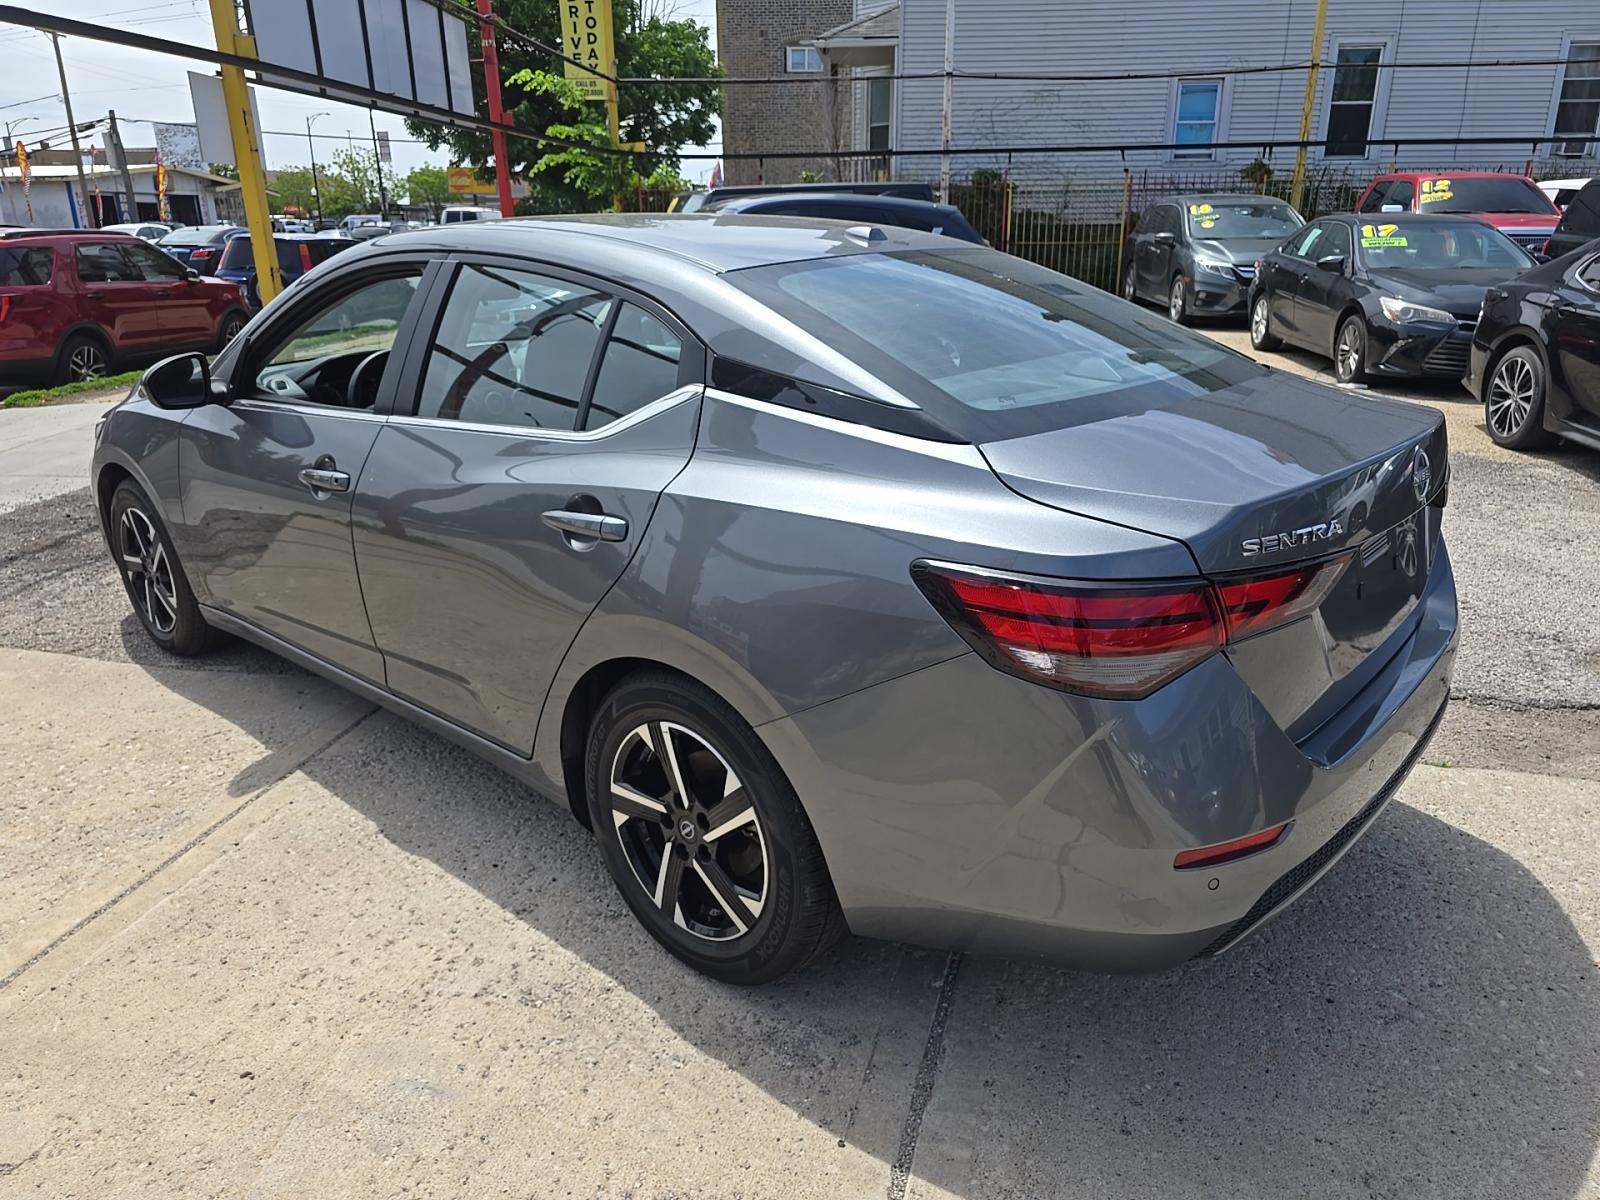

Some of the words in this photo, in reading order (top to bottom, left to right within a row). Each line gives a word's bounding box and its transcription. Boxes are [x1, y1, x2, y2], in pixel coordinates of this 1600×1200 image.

[567, 0, 582, 64] RIVE
[585, 1, 600, 75] TODAY
[1361, 223, 1399, 238] 17
[1242, 519, 1343, 557] SENTRA
